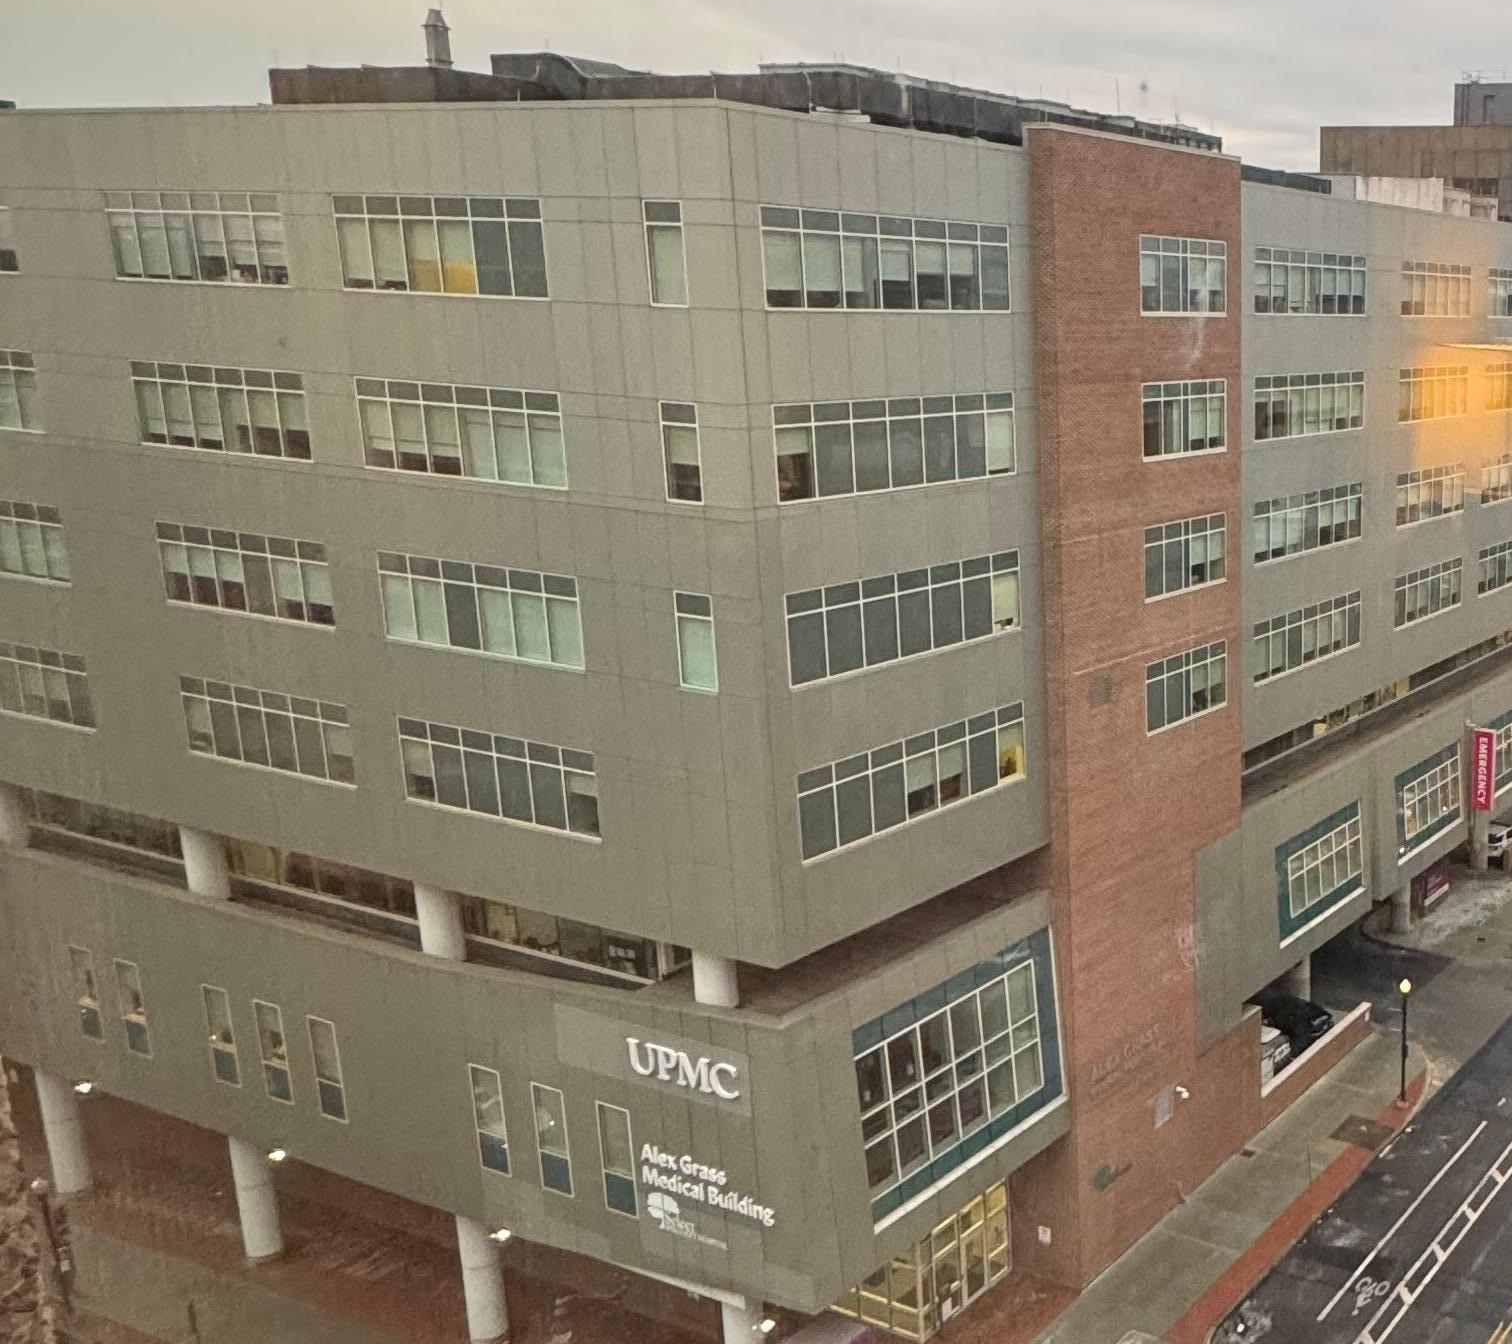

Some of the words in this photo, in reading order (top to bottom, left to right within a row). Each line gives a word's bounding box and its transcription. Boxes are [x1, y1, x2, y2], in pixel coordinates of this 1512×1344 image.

[1476, 736, 1488, 804] EMERGENCY
[626, 1037, 740, 1100] UPMC
[641, 1143, 678, 1171] Alex
[679, 1155, 727, 1186] Grass
[642, 1165, 705, 1202] Medical
[707, 1185, 775, 1227] Building
